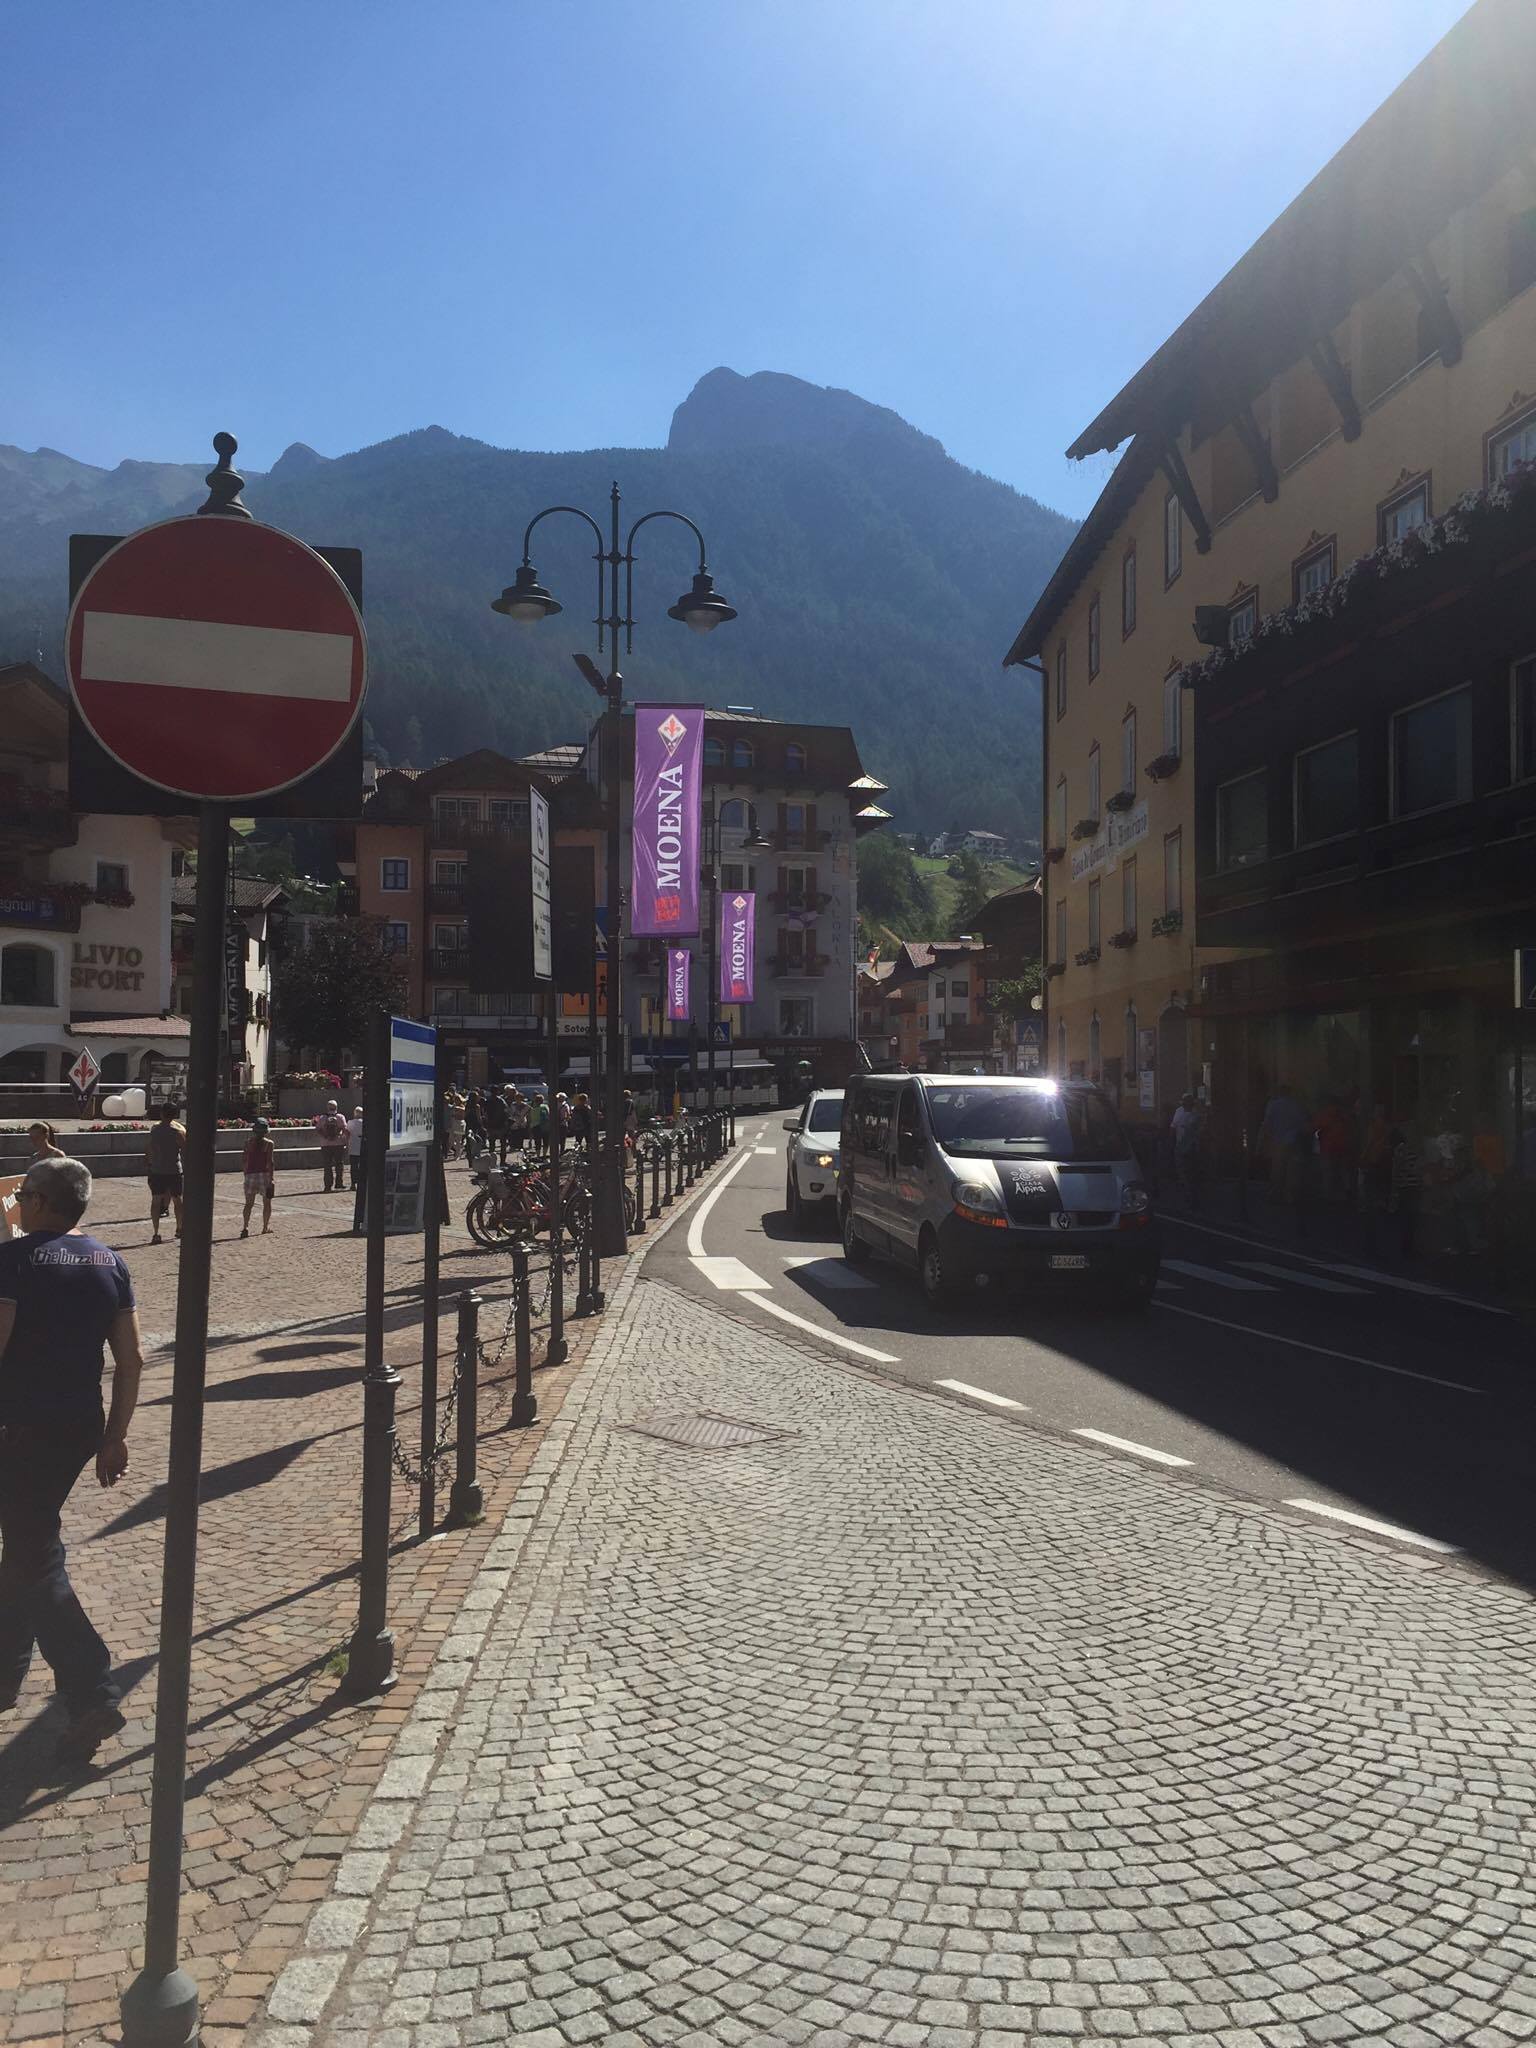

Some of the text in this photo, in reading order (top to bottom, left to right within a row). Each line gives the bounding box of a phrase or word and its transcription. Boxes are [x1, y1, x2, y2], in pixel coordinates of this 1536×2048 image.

[657, 764, 683, 890] MOENA
[72, 941, 143, 967] LIVIO
[732, 919, 746, 981] MOENA
[70, 967, 145, 991] SPORT
[226, 933, 240, 1026] MOENA
[675, 966, 684, 1007] MOENA
[405, 1098, 434, 1132] parchegg
[1015, 1182, 1046, 1195] Alpina
